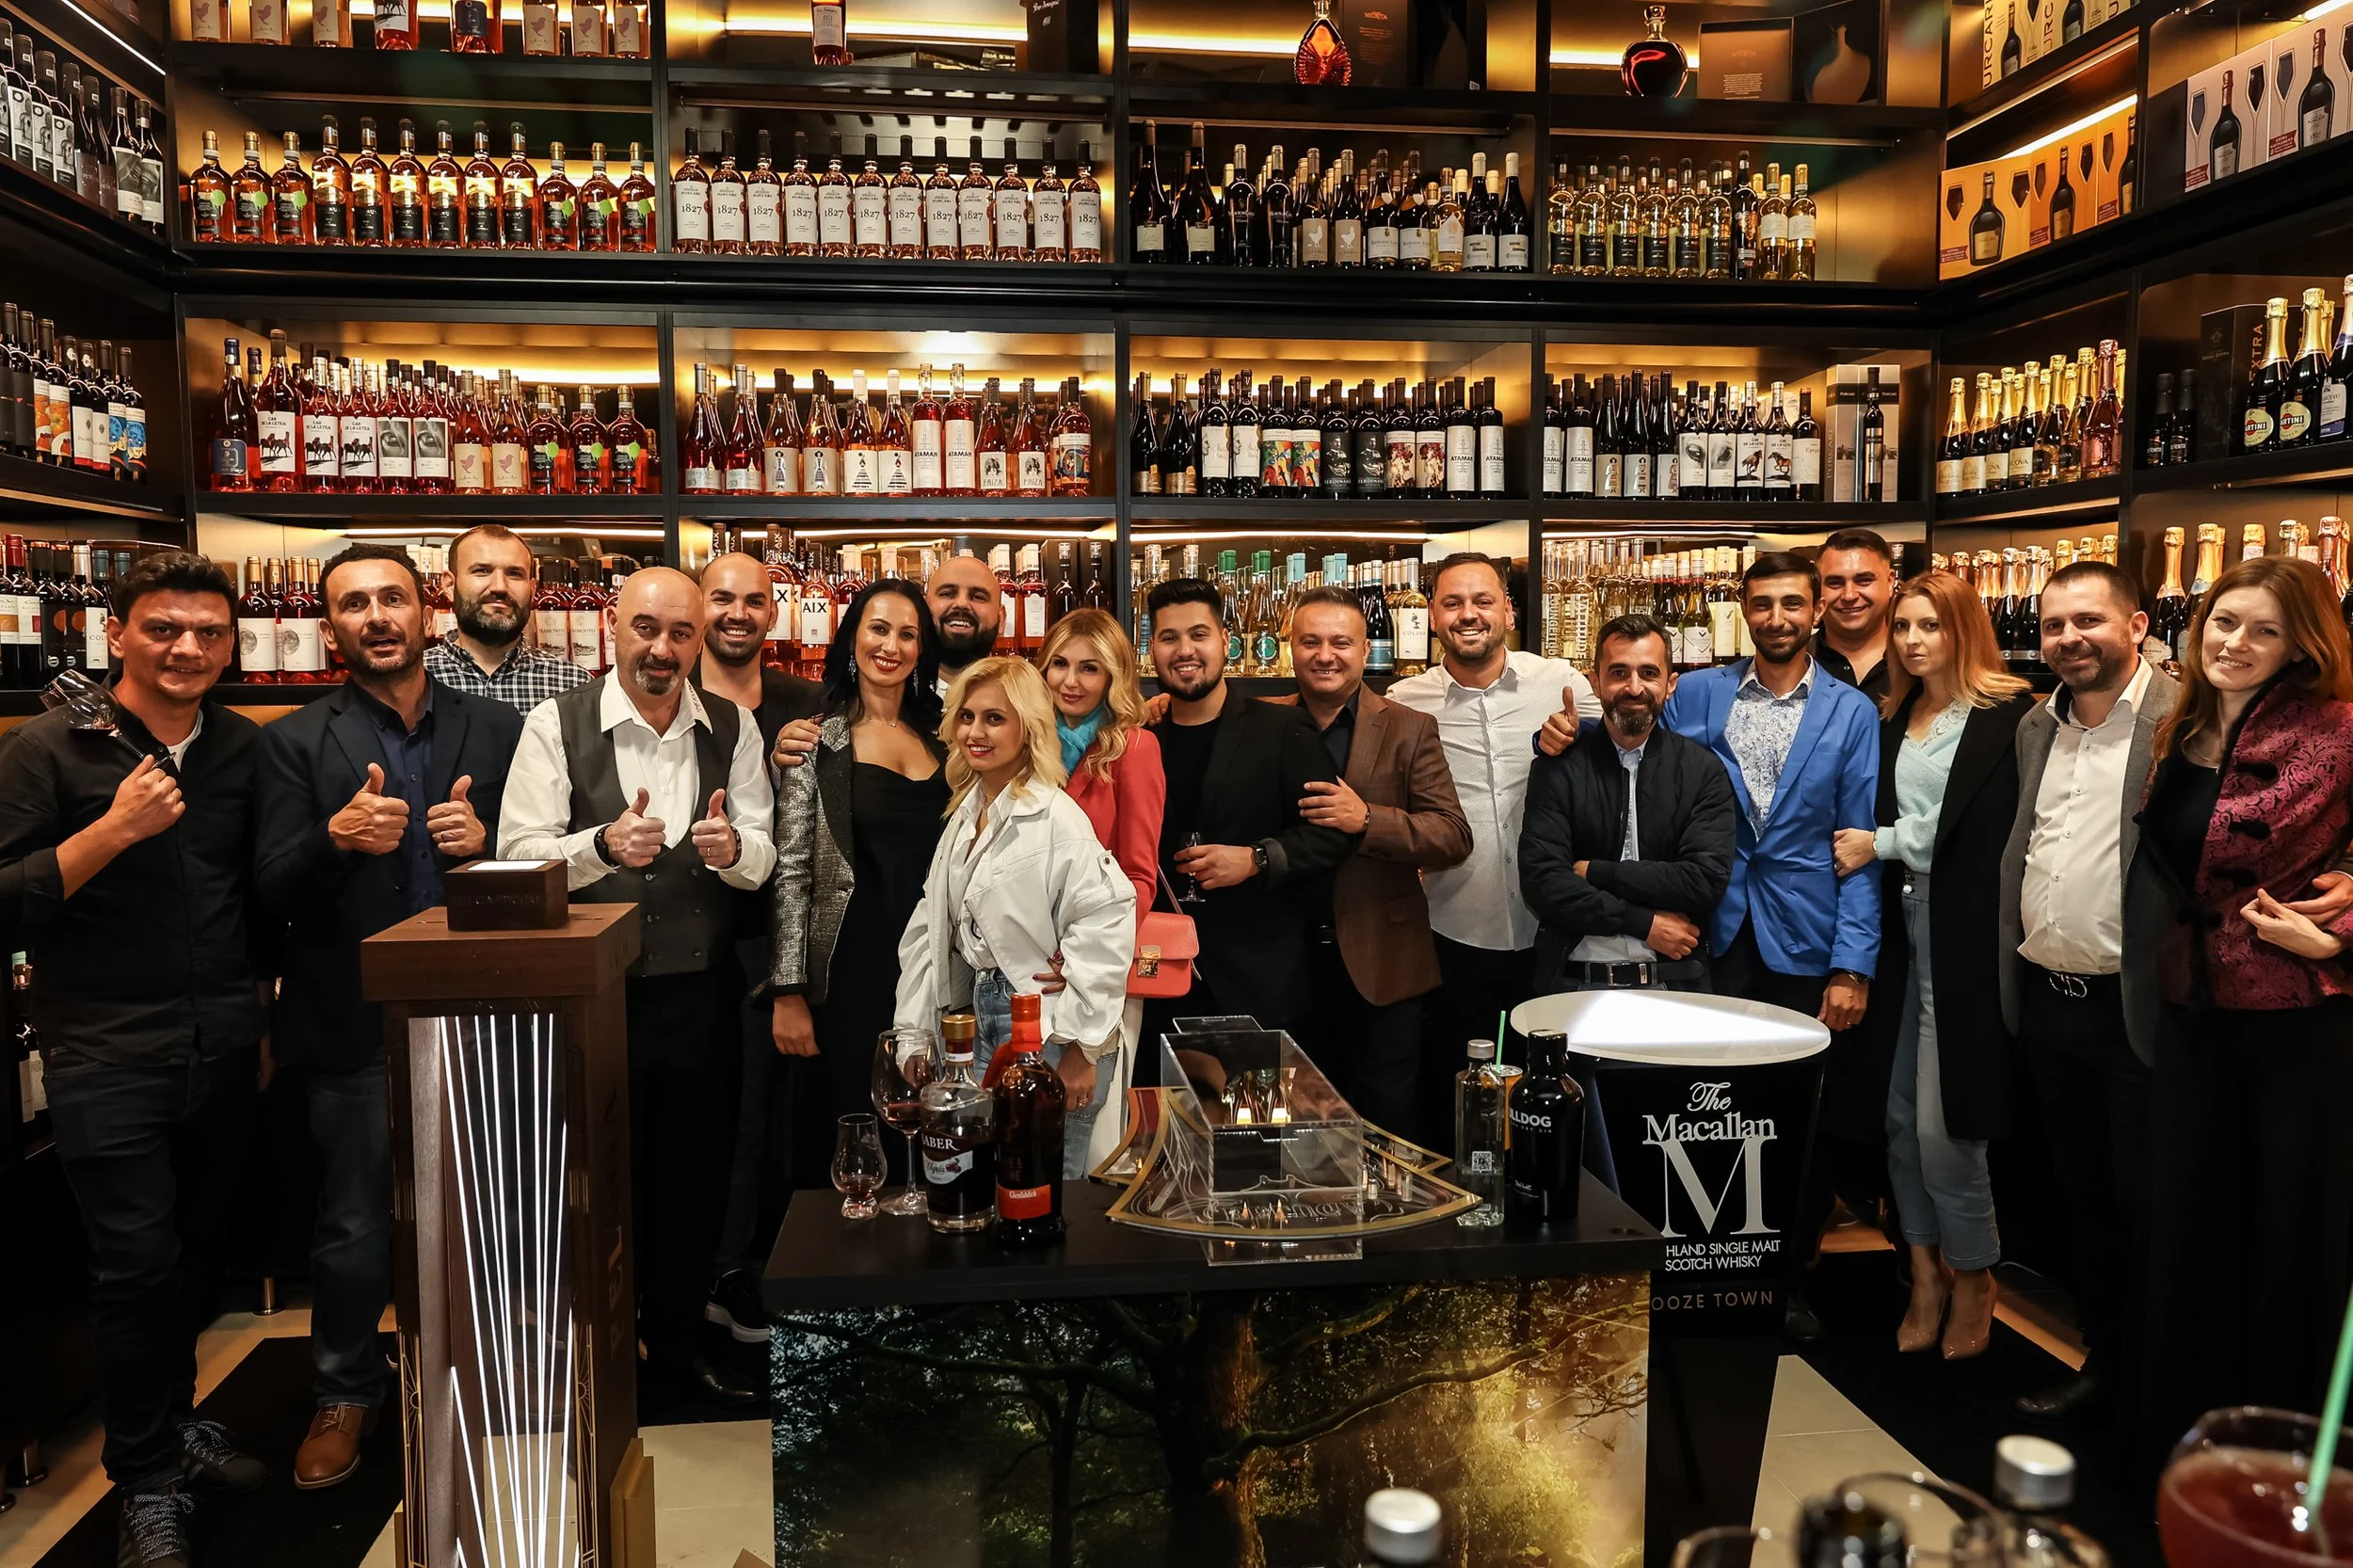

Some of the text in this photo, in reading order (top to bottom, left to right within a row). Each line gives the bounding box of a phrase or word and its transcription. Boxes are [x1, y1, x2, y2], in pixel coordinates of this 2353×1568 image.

[681, 205, 702, 216] 1827
[717, 206, 738, 216] 1827
[754, 206, 774, 216] 1827
[792, 208, 813, 218] 1827
[824, 208, 844, 218] 1827
[860, 209, 880, 219] 1827
[895, 211, 915, 221] 1827
[933, 211, 952, 222] 1827
[964, 211, 984, 221] 1827
[1002, 212, 1022, 222] 1827
[1040, 213, 1060, 223] 1827
[1079, 214, 1098, 224] 1827
[776, 589, 789, 602] X
[803, 601, 827, 613] AIX
[1687, 1081, 1732, 1112] The
[1641, 1112, 1778, 1144] Macallan
[1642, 1135, 1781, 1238] M
[1666, 1240, 1781, 1256] HLAND SINGLE MALT
[1665, 1256, 1762, 1272] SCOTCH WHISKY
[1651, 1290, 1773, 1310] OOZE TOWN
